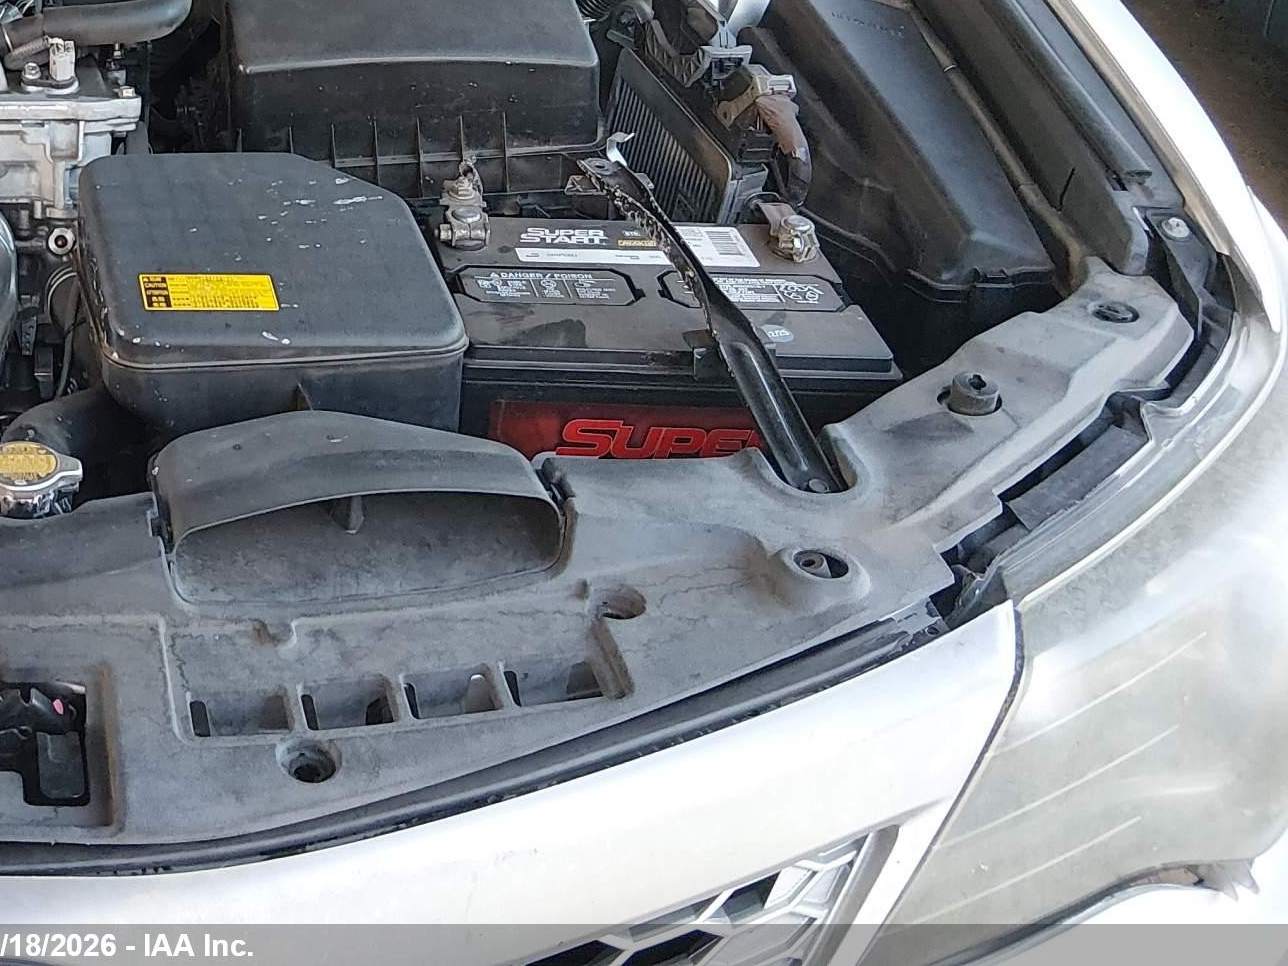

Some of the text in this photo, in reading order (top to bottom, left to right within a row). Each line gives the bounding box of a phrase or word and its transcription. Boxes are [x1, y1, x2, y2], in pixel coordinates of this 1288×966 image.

[526, 227, 604, 237] SUPER
[519, 234, 608, 244] START
[555, 418, 762, 459] SUPE
